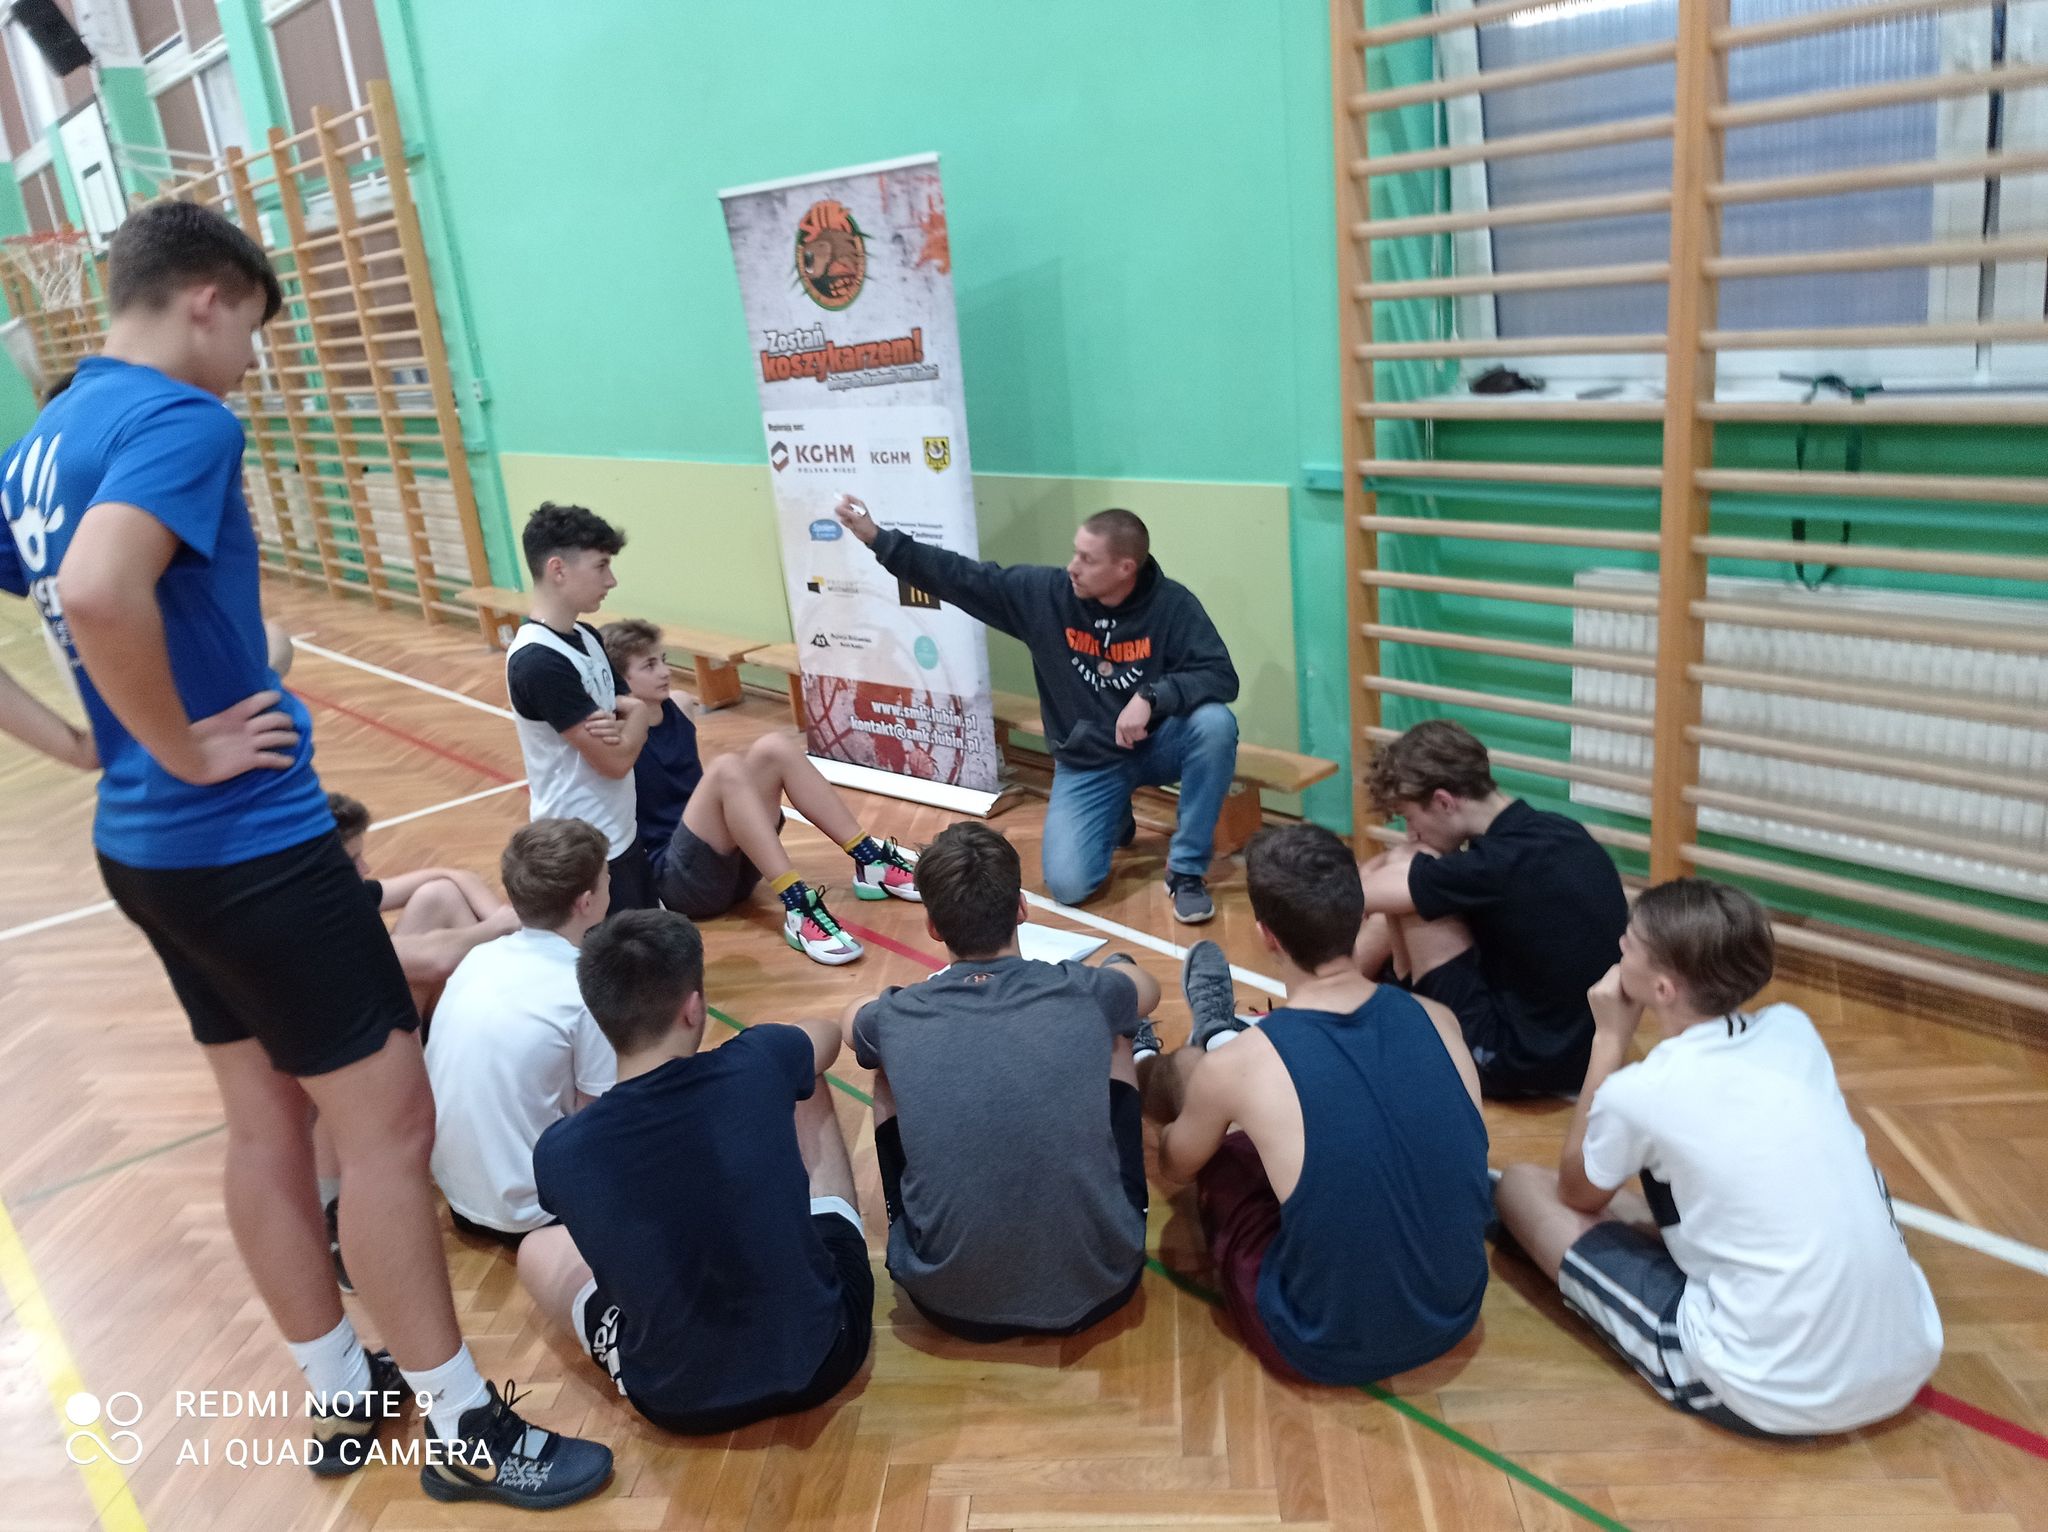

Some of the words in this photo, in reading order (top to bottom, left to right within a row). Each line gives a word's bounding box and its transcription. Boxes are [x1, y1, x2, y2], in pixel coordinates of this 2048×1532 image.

[764, 322, 827, 354] Zostań
[761, 327, 924, 382] koszykarzem!
[795, 444, 855, 464] KGHM
[870, 451, 912, 465] KGHM
[871, 701, 977, 732] www.smk.lubin.pl
[850, 716, 980, 755] kontakt@smk.lubin.pl
